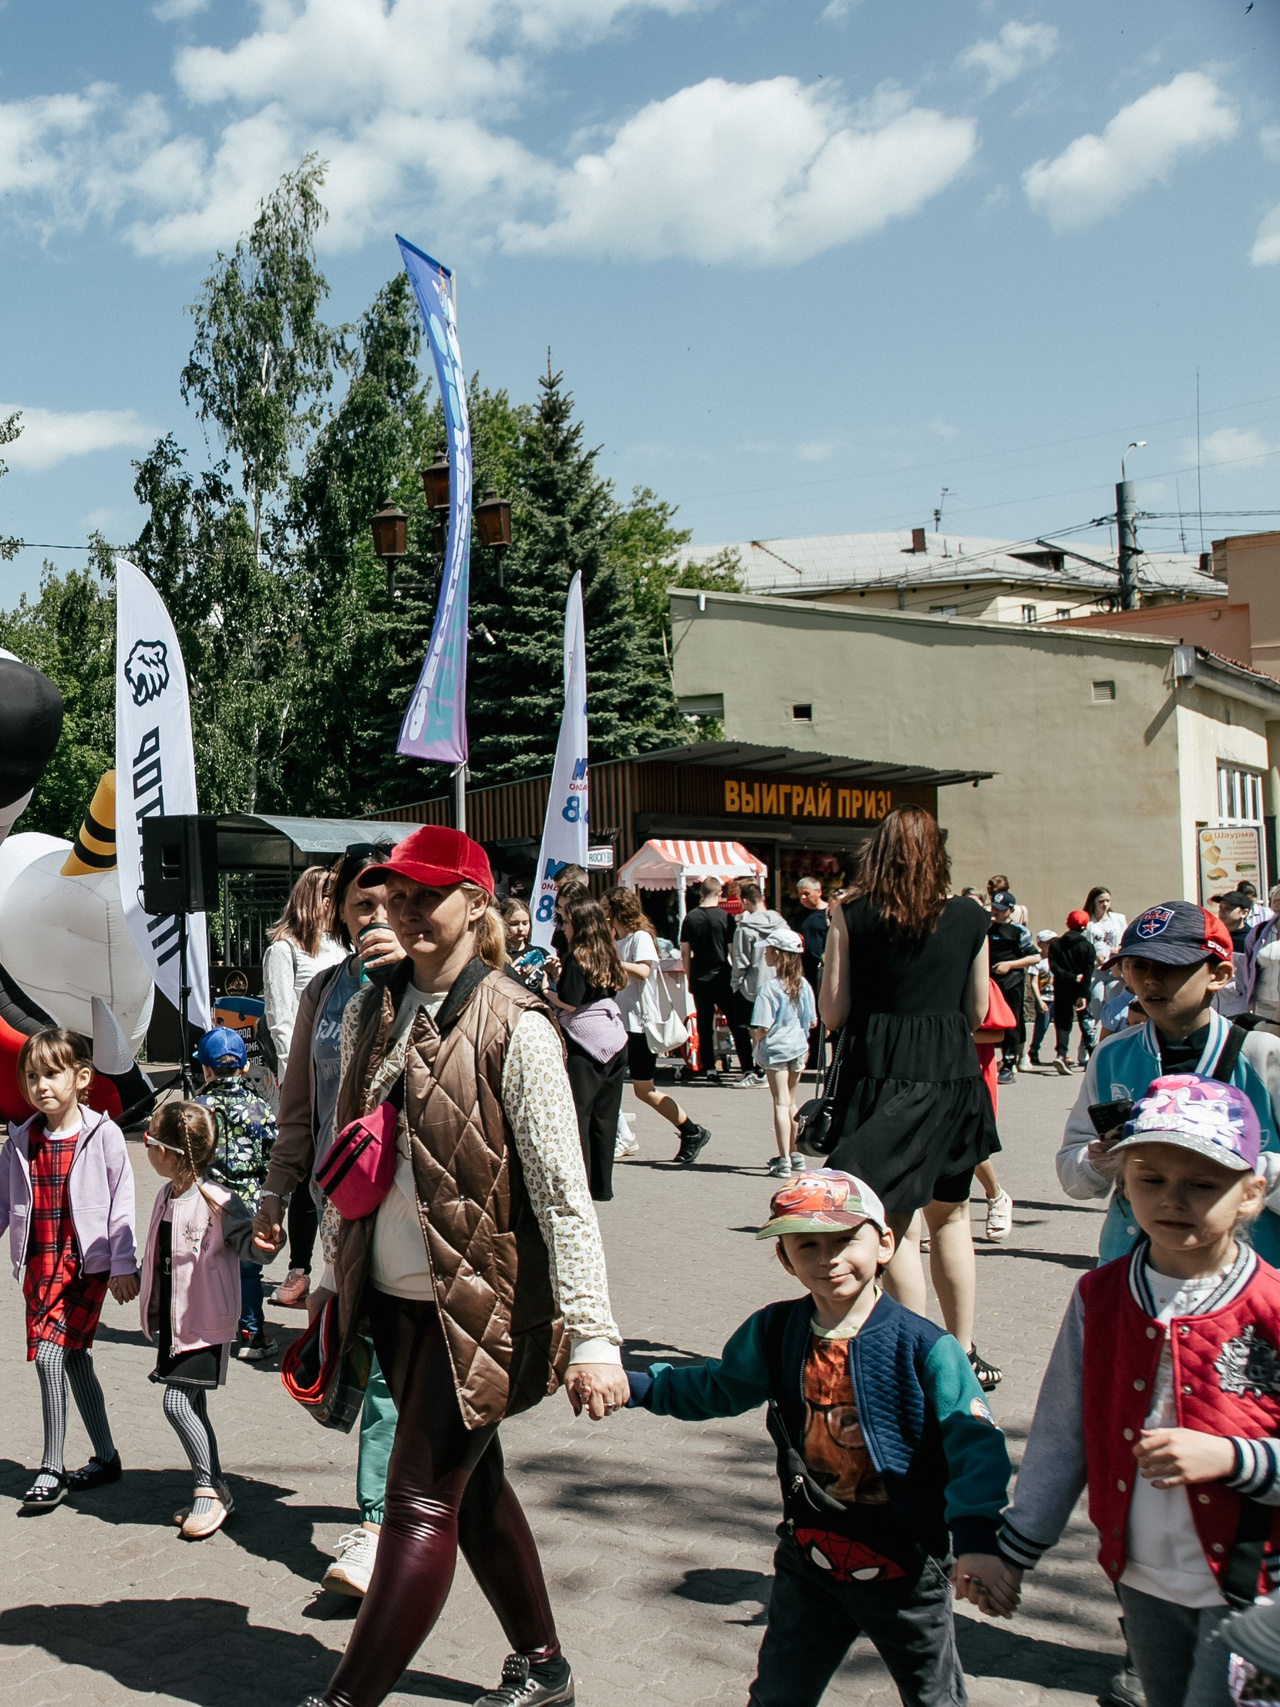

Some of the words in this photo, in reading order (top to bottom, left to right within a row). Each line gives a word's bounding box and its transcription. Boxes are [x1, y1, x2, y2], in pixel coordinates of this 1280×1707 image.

[724, 779, 831, 818] ВЫИГРАЙ
[837, 788, 891, 820] ПРИЗ!
[1214, 831, 1254, 840] Шаурма
